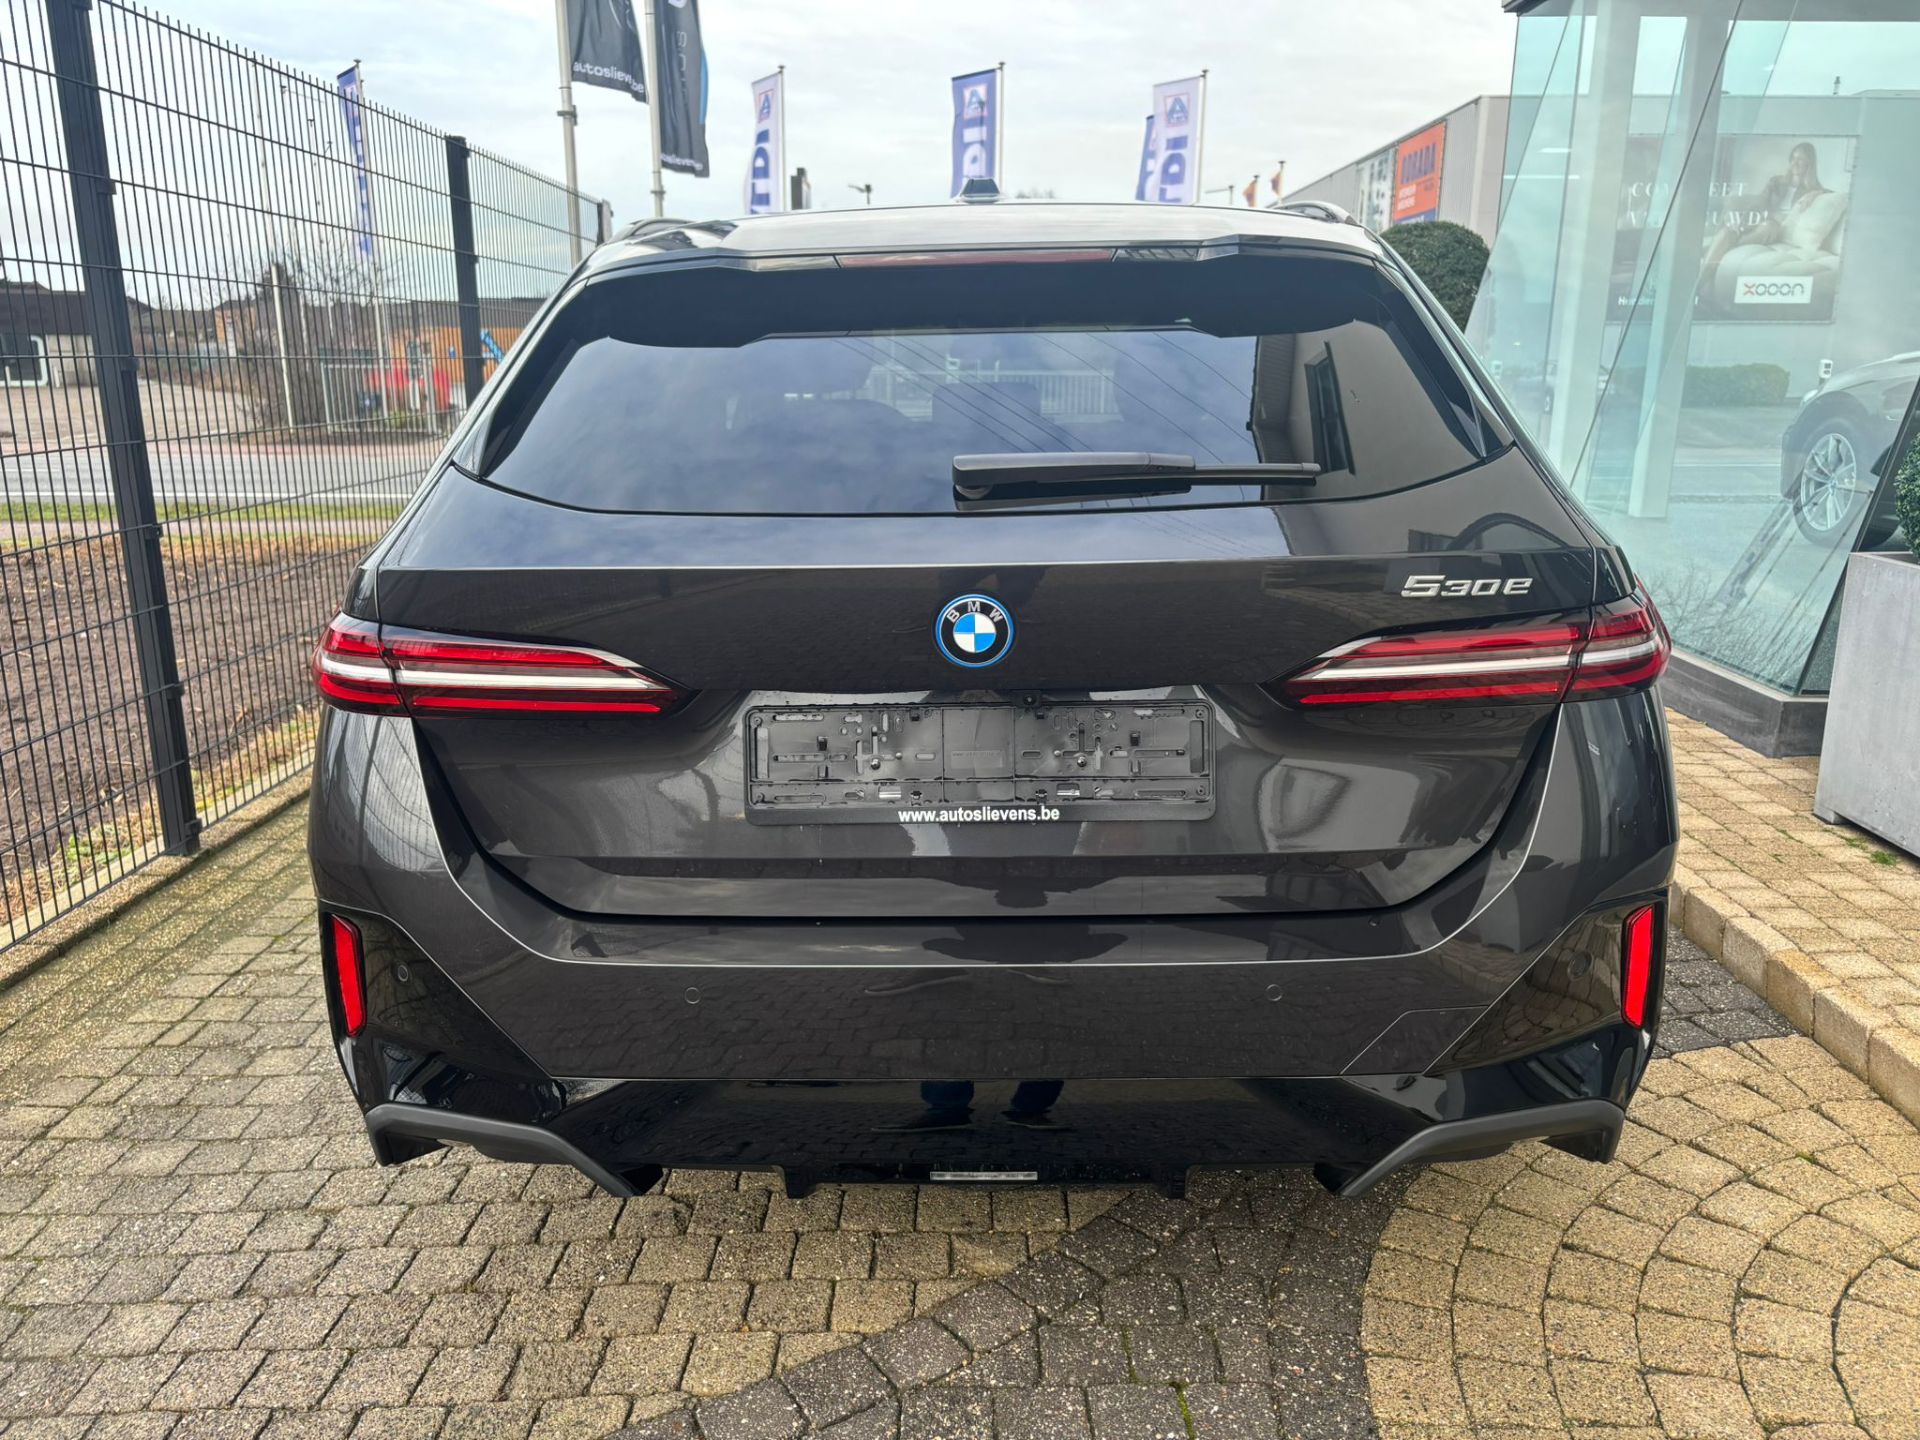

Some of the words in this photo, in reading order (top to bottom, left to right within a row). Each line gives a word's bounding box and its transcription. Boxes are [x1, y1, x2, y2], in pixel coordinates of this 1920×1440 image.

[1401, 575, 1533, 597] 530e
[946, 601, 1004, 623] BMW
[898, 806, 1060, 823] www.autoslievens.be
